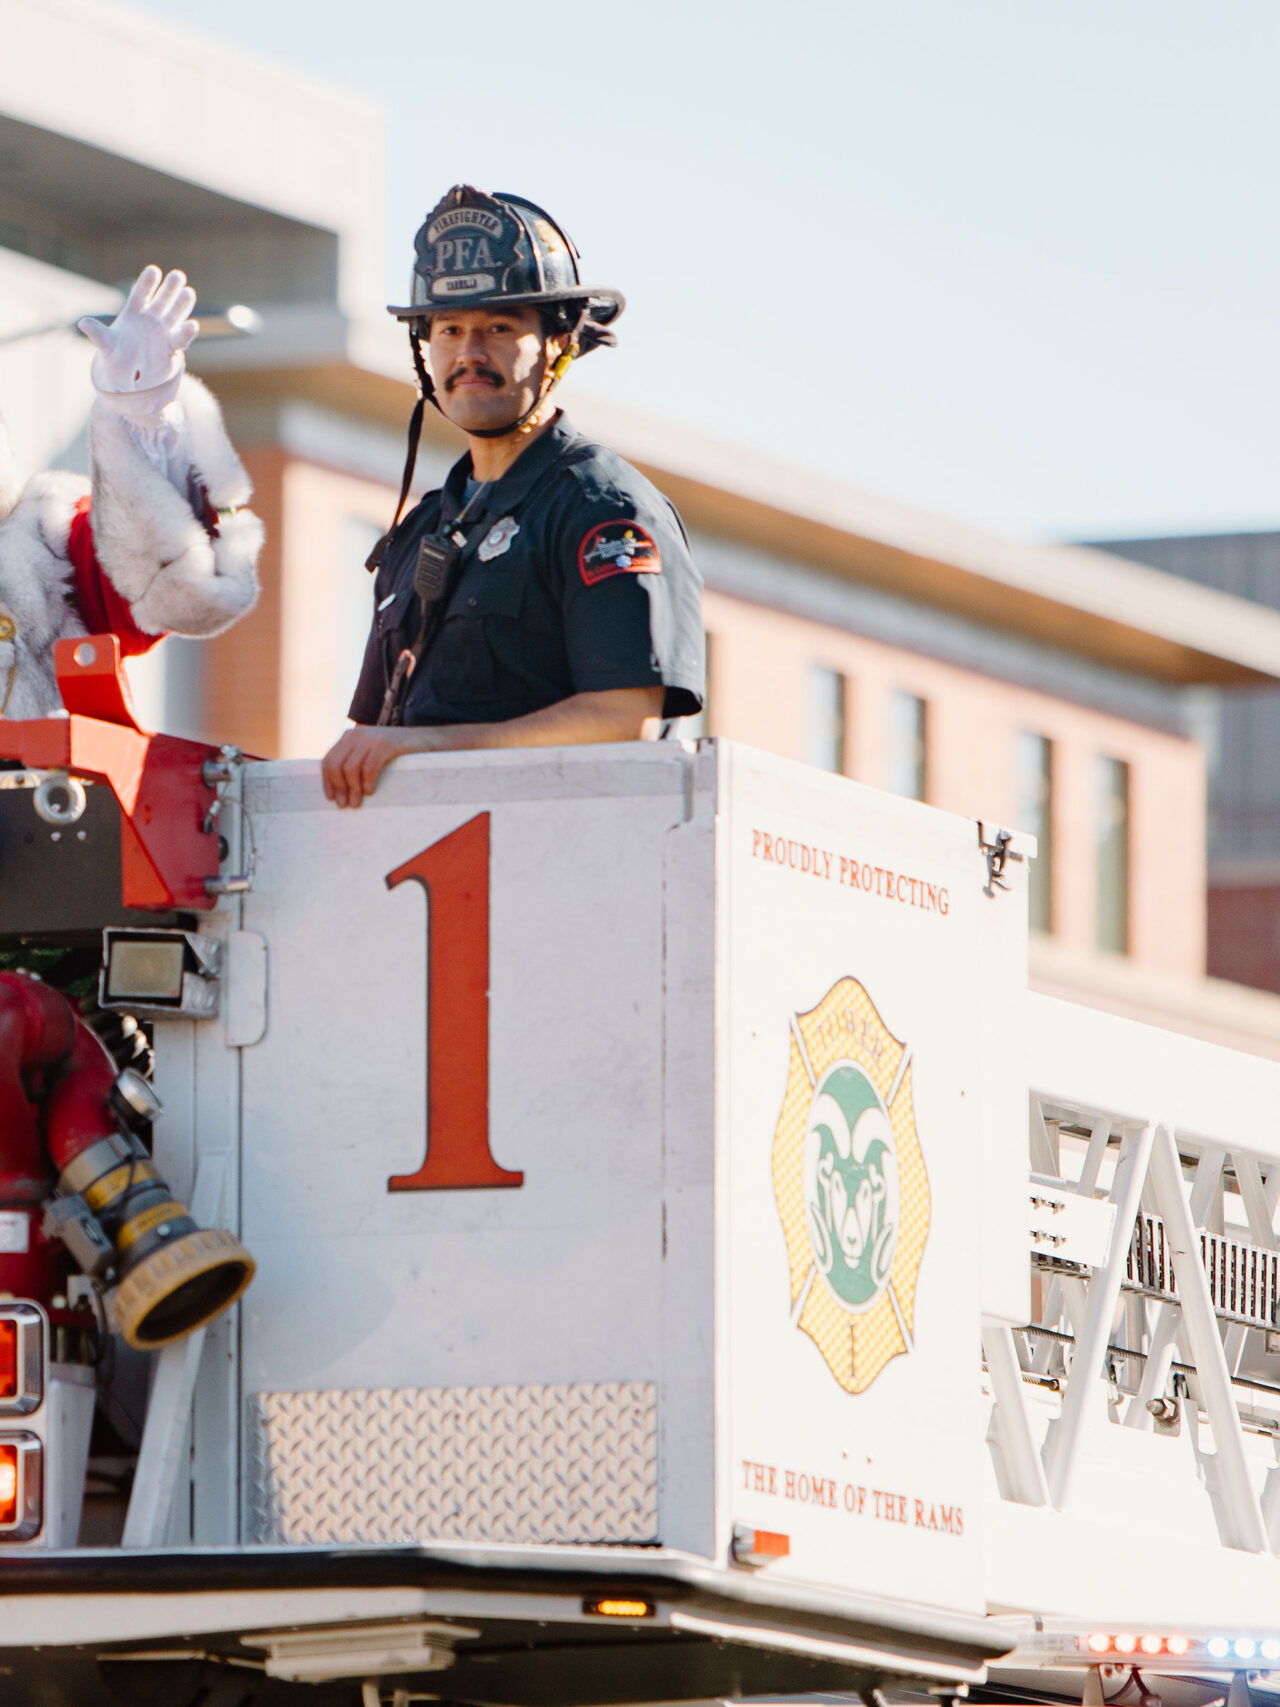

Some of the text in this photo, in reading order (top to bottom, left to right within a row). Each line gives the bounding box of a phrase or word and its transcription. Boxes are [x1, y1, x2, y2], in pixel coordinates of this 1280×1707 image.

[433, 238, 496, 272] PFA
[435, 211, 498, 233] FIREFIGHTER
[751, 828, 950, 917] PROUDLY PROTECTING
[385, 810, 524, 1194] 1
[741, 1460, 965, 1536] THE HOME OF THE RAMS
